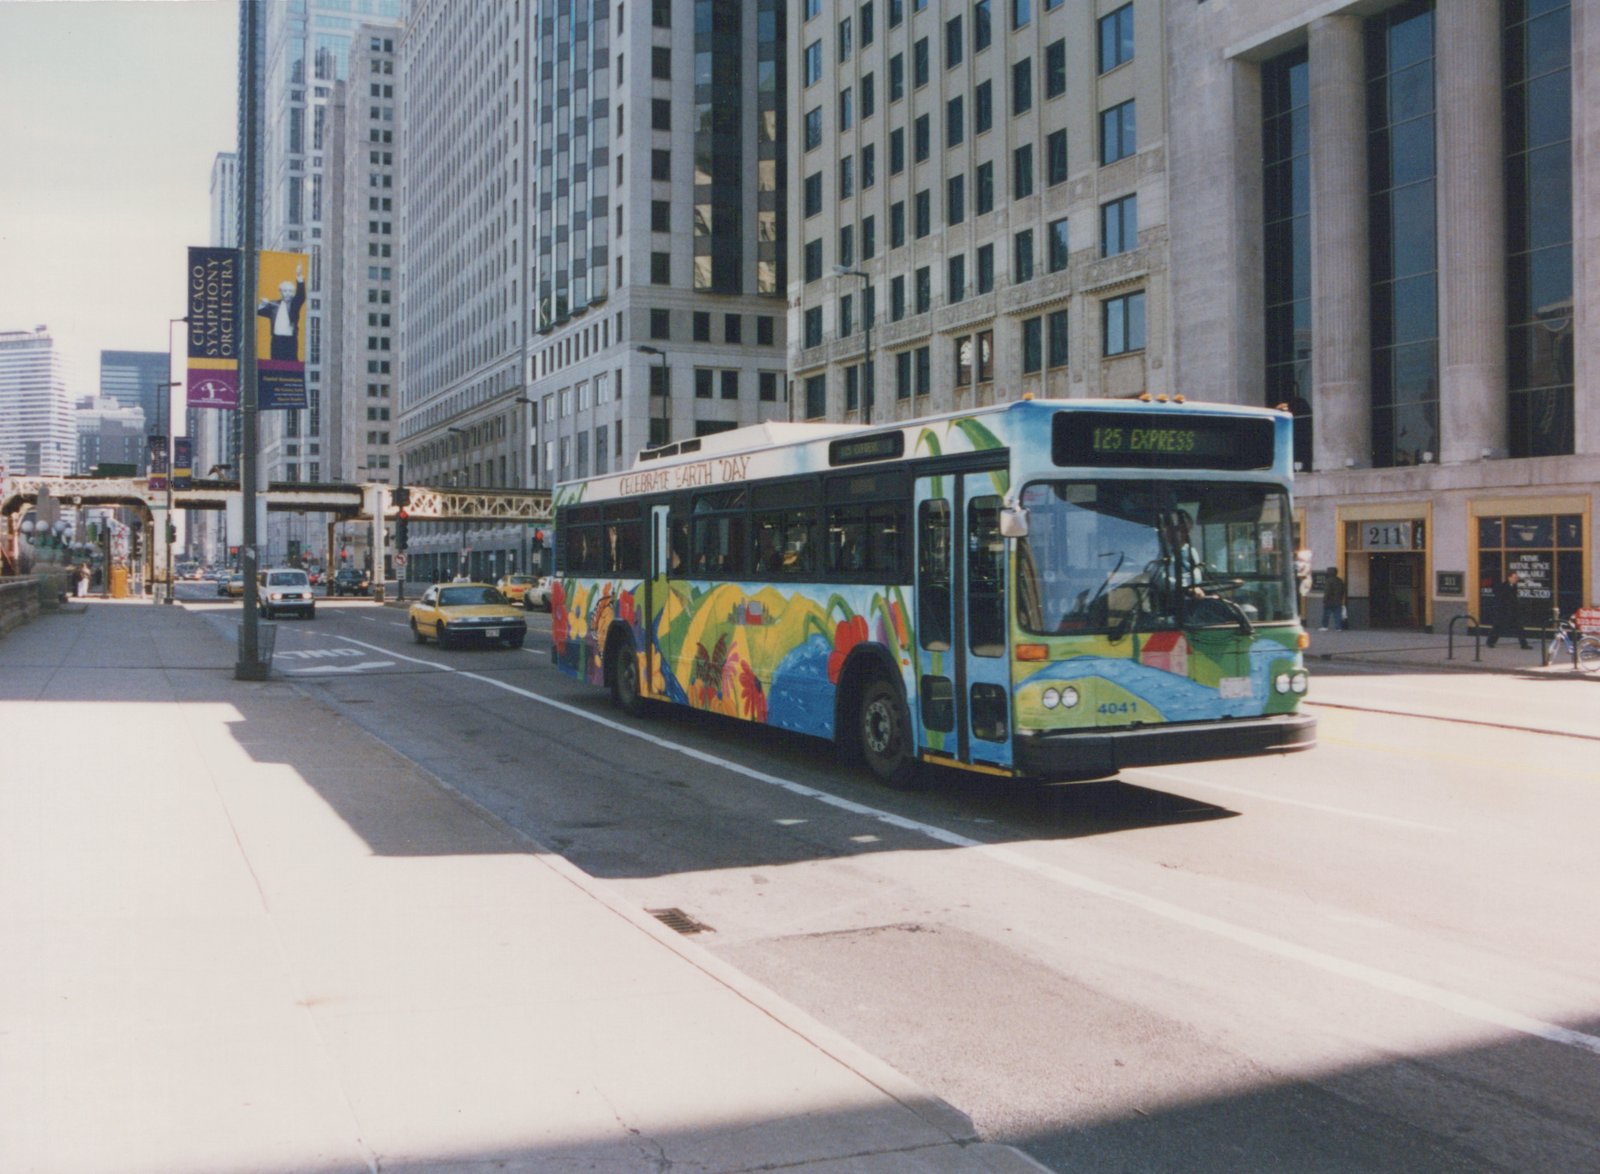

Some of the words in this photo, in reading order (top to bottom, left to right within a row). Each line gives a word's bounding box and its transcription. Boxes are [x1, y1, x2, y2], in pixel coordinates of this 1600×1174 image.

[192, 265, 205, 346] CHICAGO
[206, 257, 219, 355] SYMPHONY
[220, 258, 233, 356] ORCHESTRA
[1093, 428, 1122, 449] 125
[1131, 429, 1195, 451] EXPRESS
[619, 470, 670, 496] CELEBRATE
[676, 462, 713, 488] EARTH
[721, 456, 751, 482] DAY
[1369, 527, 1402, 545] 211
[1097, 702, 1138, 714] 4041
